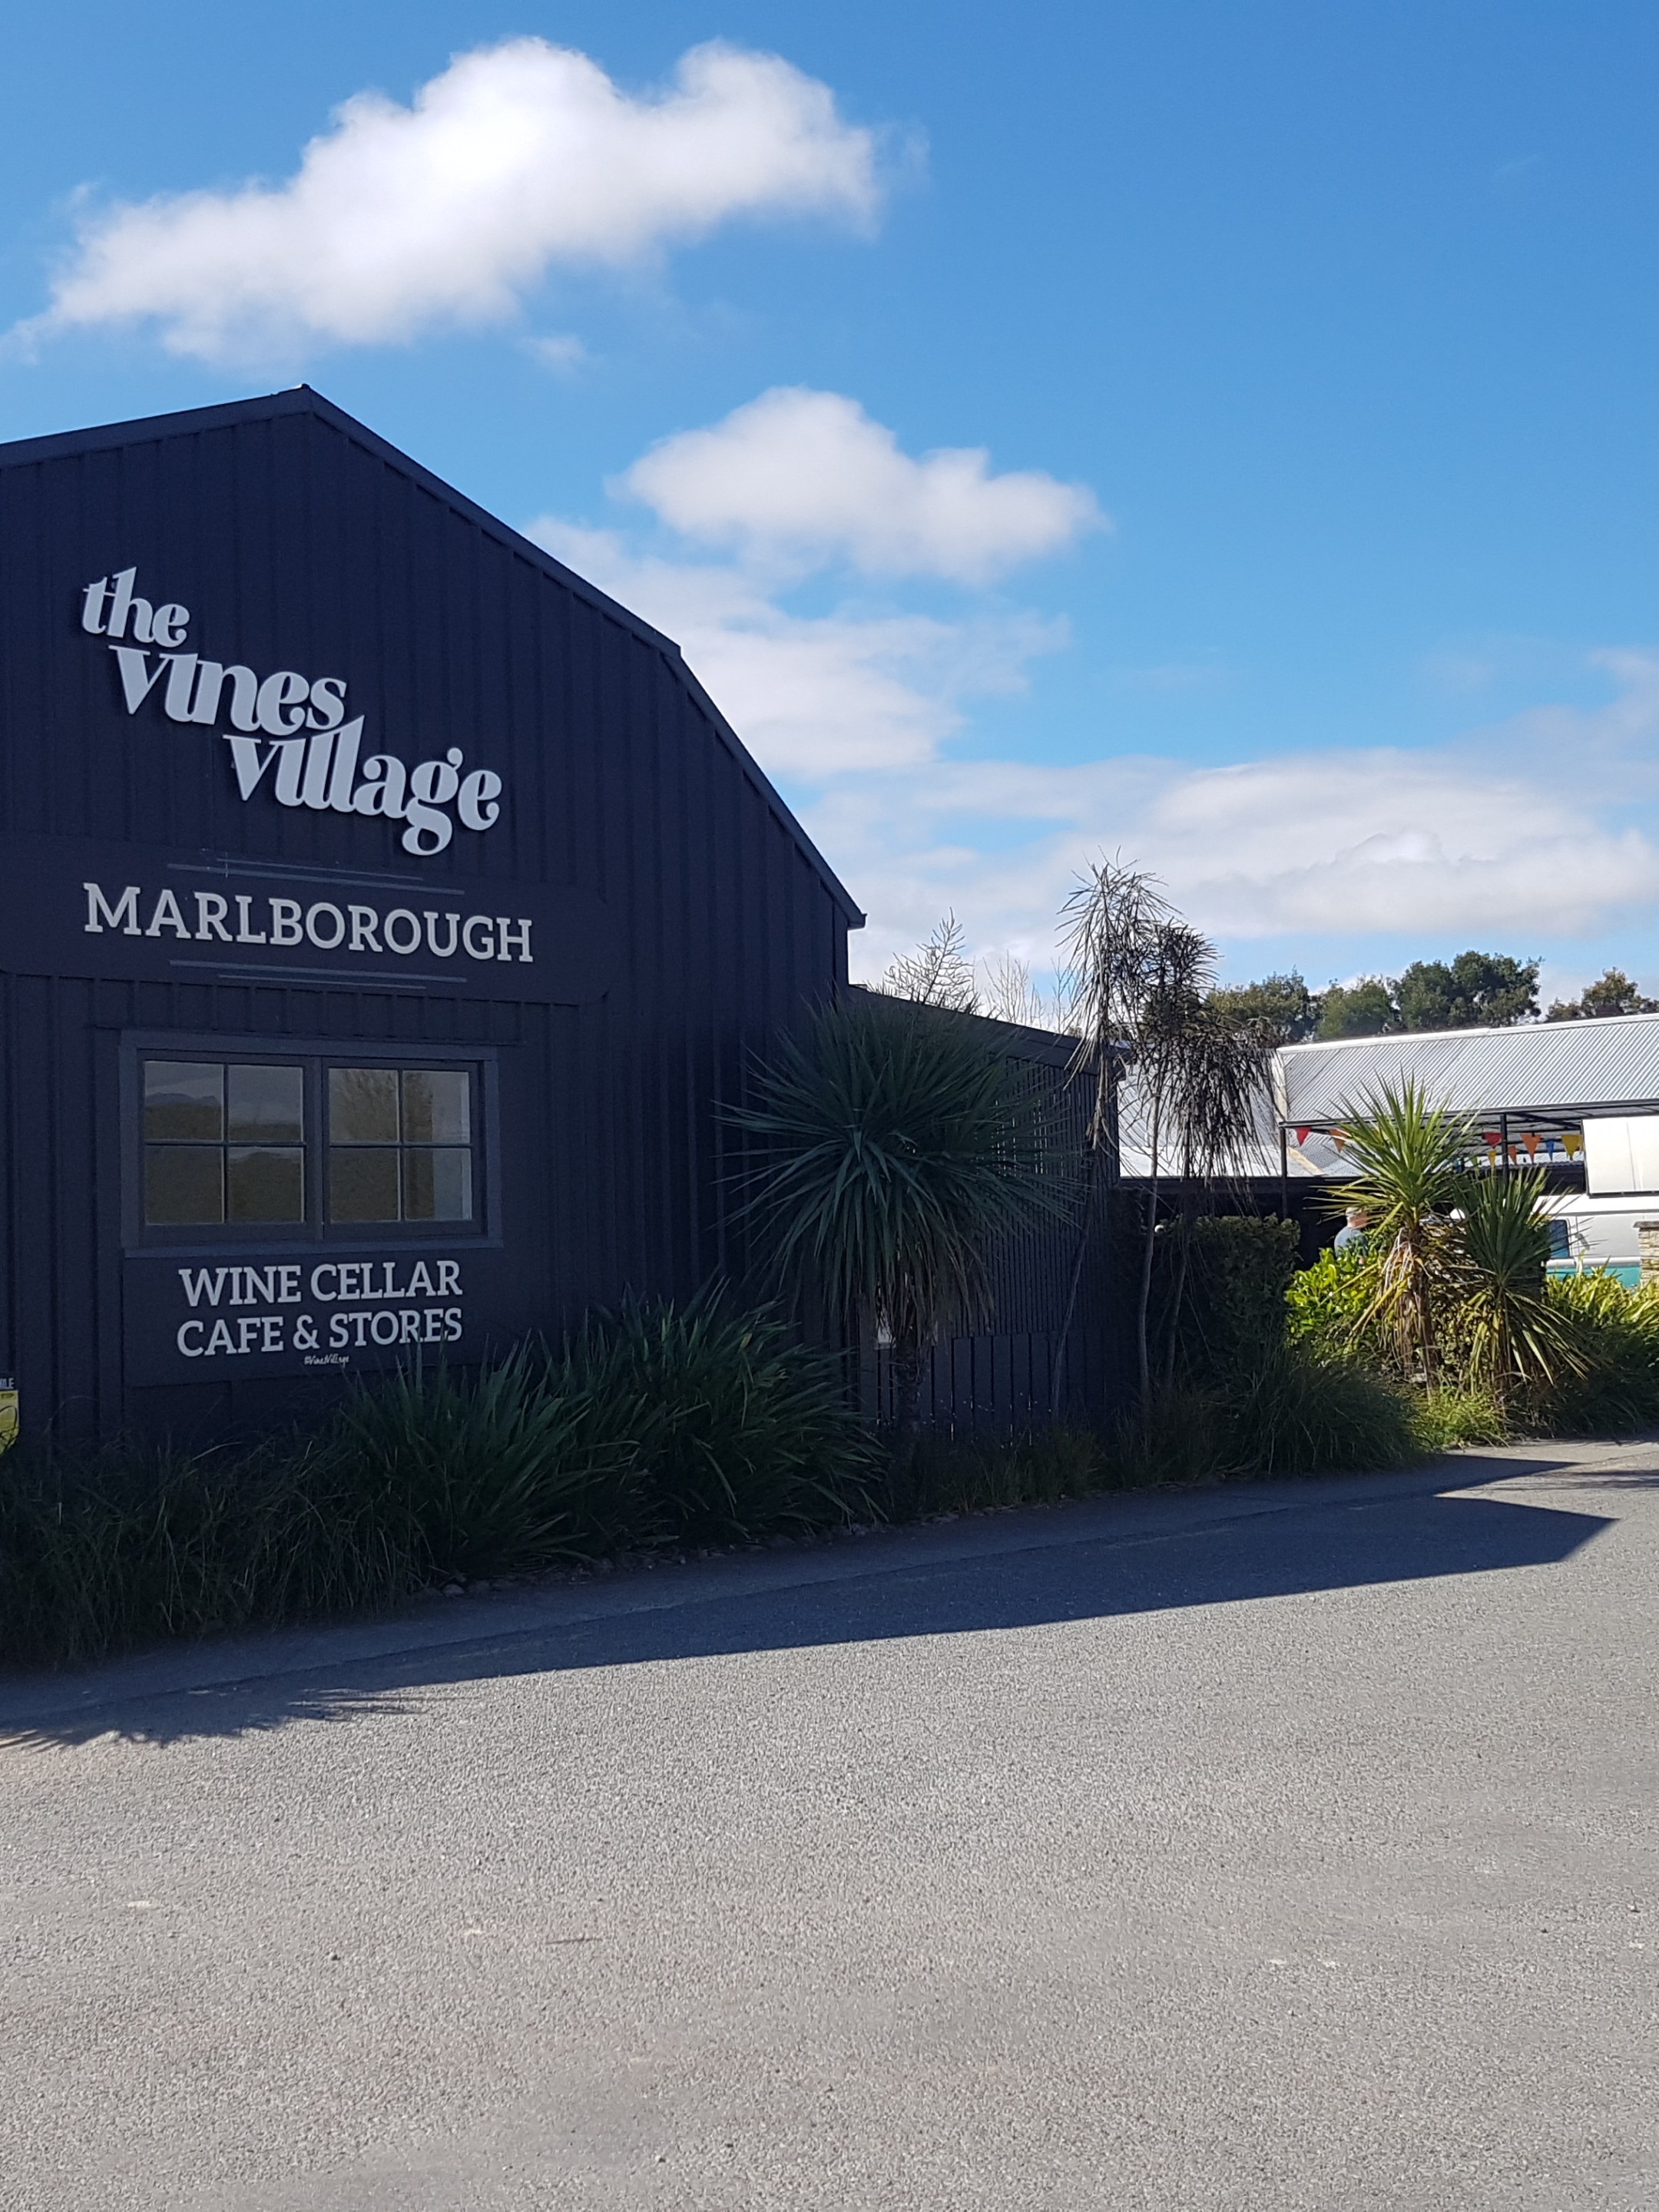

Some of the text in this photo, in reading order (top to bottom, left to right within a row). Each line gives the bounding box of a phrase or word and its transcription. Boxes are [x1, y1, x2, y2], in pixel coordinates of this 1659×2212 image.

[81, 567, 190, 647] the
[83, 882, 534, 962] MARLBOROUGH
[178, 1260, 462, 1306] WINE CELLAR
[177, 1308, 462, 1356] CAFE & STORES
